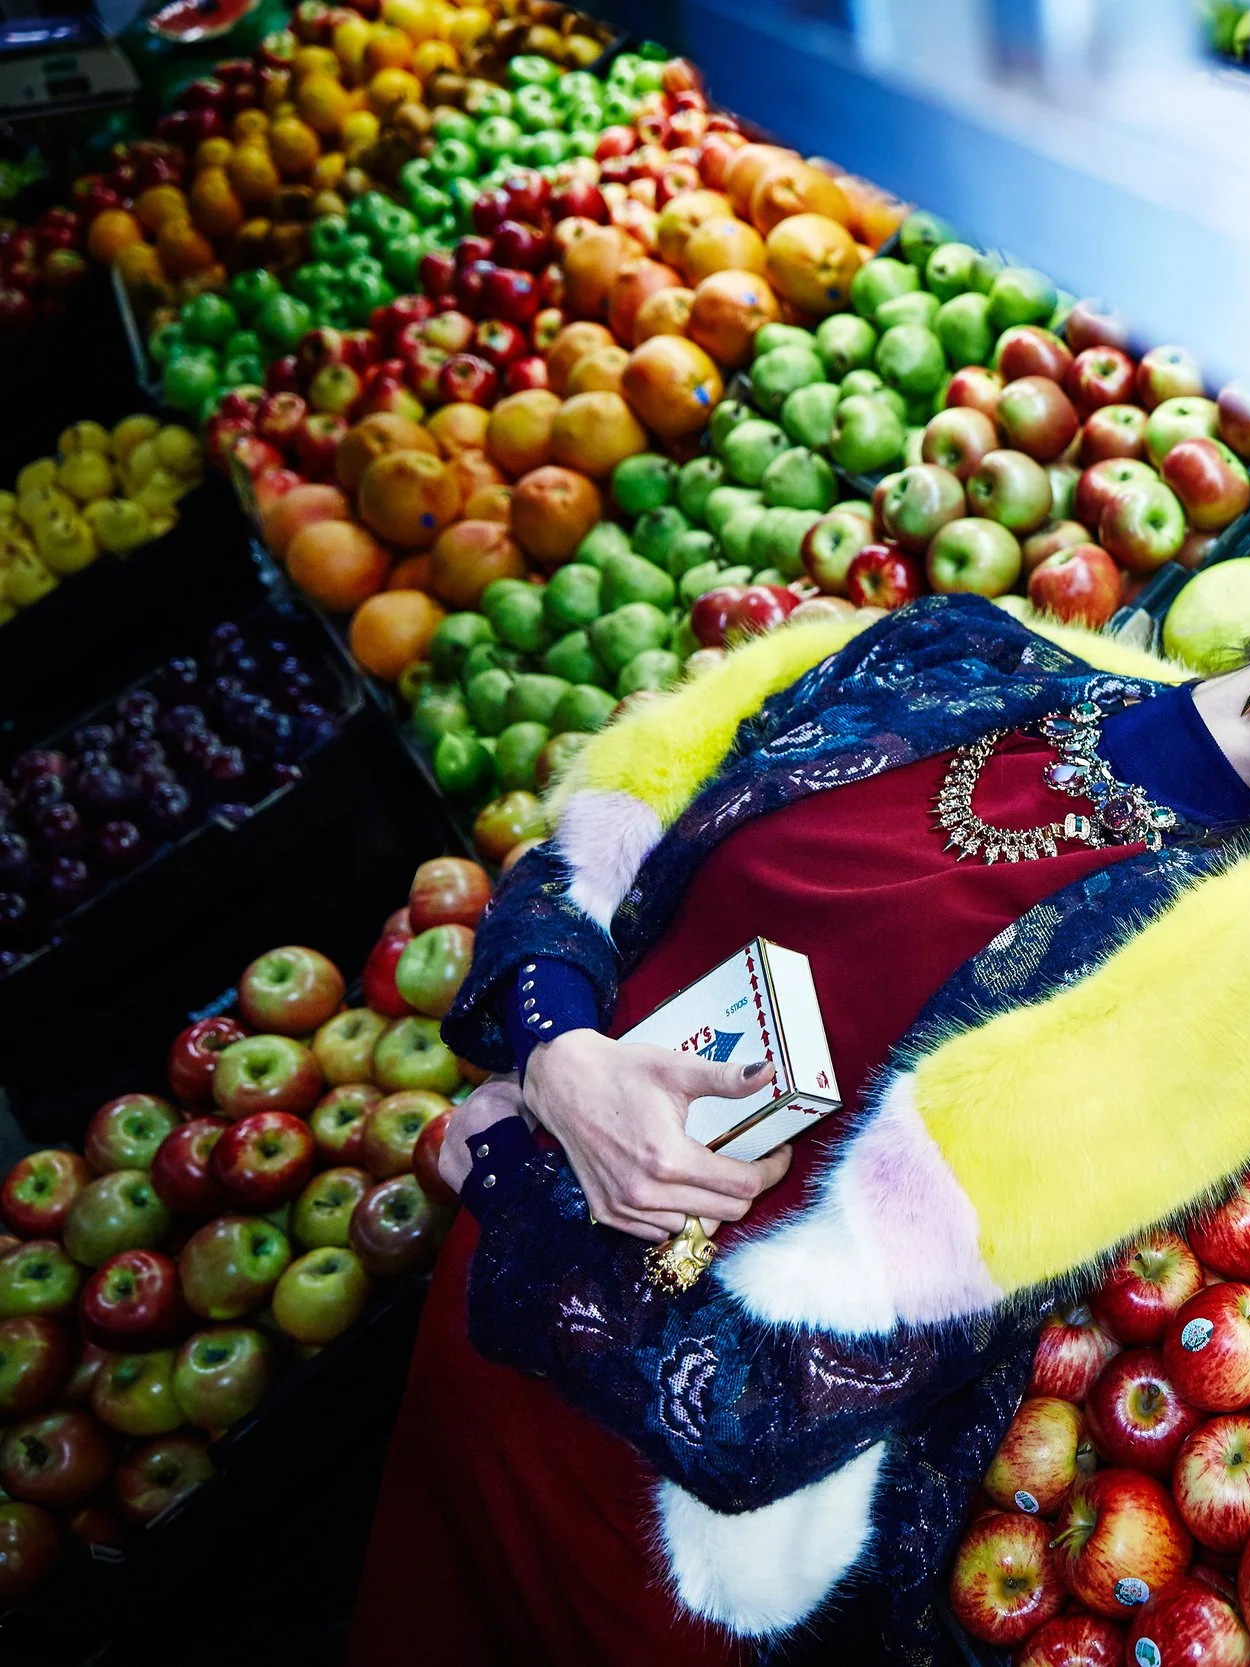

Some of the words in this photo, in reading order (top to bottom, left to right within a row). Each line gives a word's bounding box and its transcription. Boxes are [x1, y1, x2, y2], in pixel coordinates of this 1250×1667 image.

[725, 1009, 731, 1017] 5
[730, 996, 748, 1014] STICKS
[1192, 1337, 1211, 1352] AUSSIE
